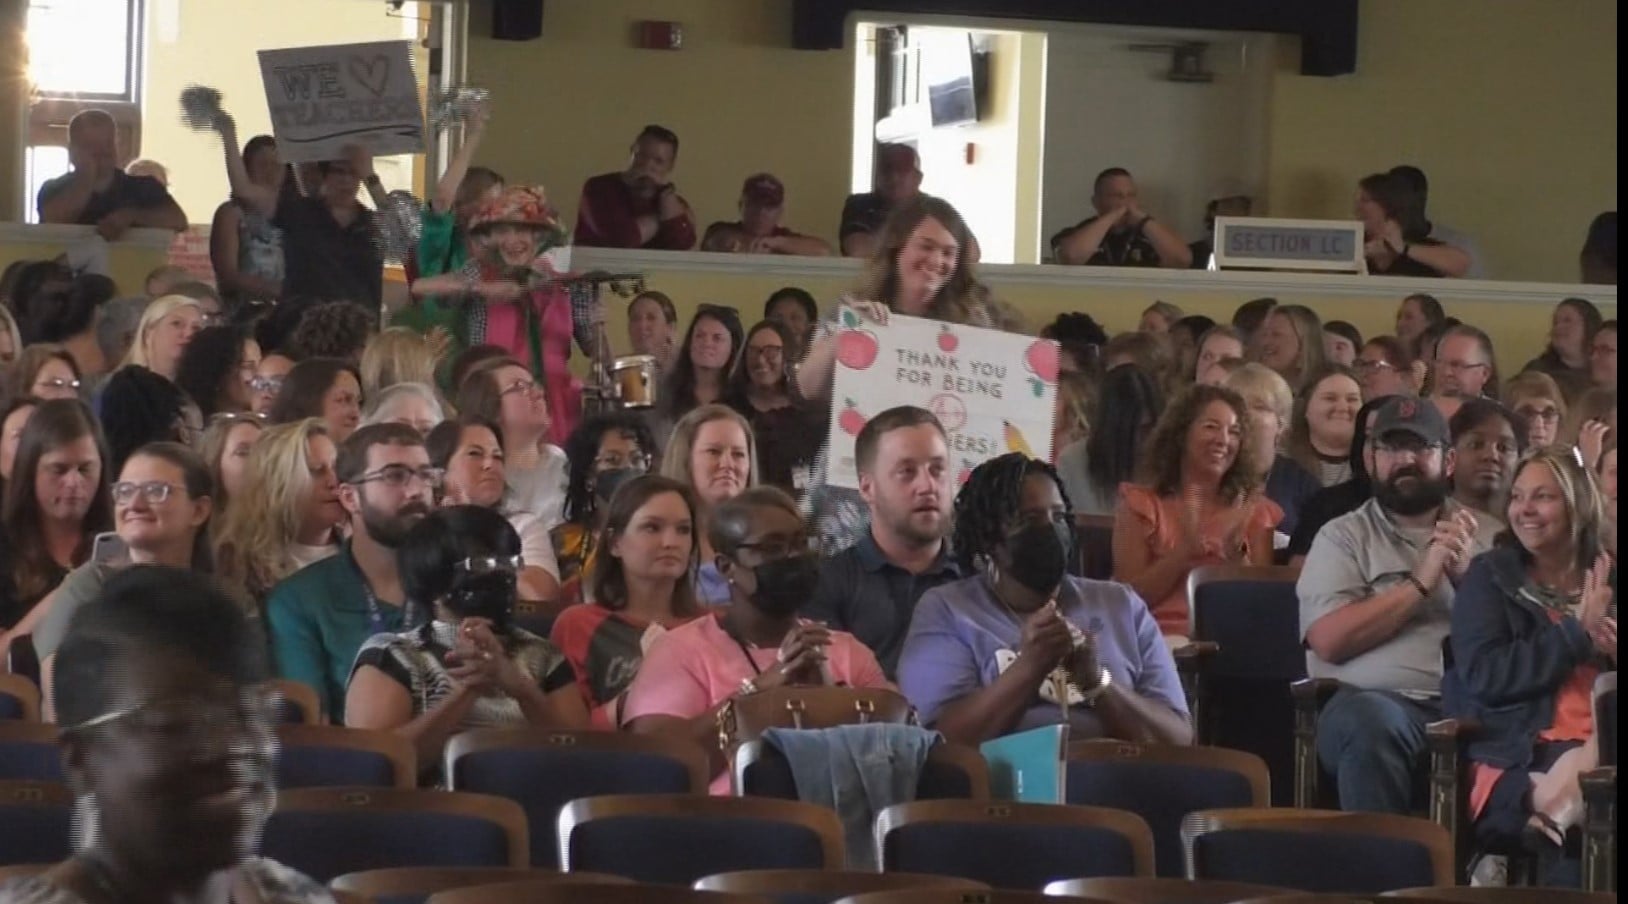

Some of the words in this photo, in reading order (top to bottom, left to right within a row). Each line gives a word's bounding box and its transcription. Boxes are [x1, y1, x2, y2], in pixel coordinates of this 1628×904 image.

[273, 62, 346, 100] WE
[1231, 232, 1312, 252] SECTION
[1321, 236, 1343, 255] LC
[896, 348, 960, 371] THANK
[969, 361, 1007, 379] YOU
[896, 368, 932, 386] FOR
[943, 375, 1002, 399] BEING
